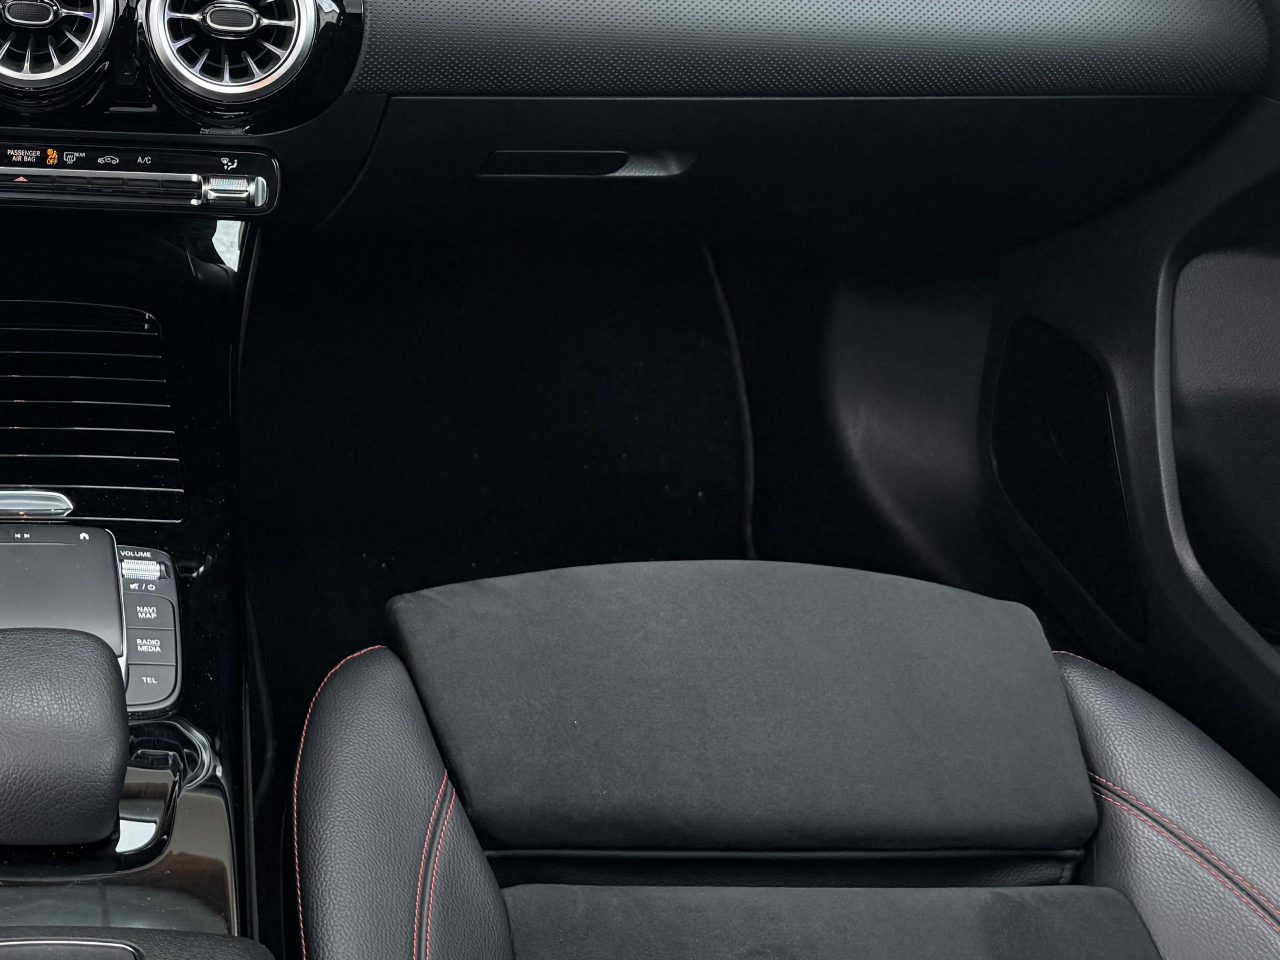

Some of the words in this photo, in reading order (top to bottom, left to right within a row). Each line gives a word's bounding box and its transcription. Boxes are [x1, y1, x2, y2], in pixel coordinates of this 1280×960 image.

[7, 149, 41, 157] PASSENGER
[136, 156, 152, 164] A/C
[120, 550, 152, 558] VOLUME
[142, 676, 158, 684] TEL
